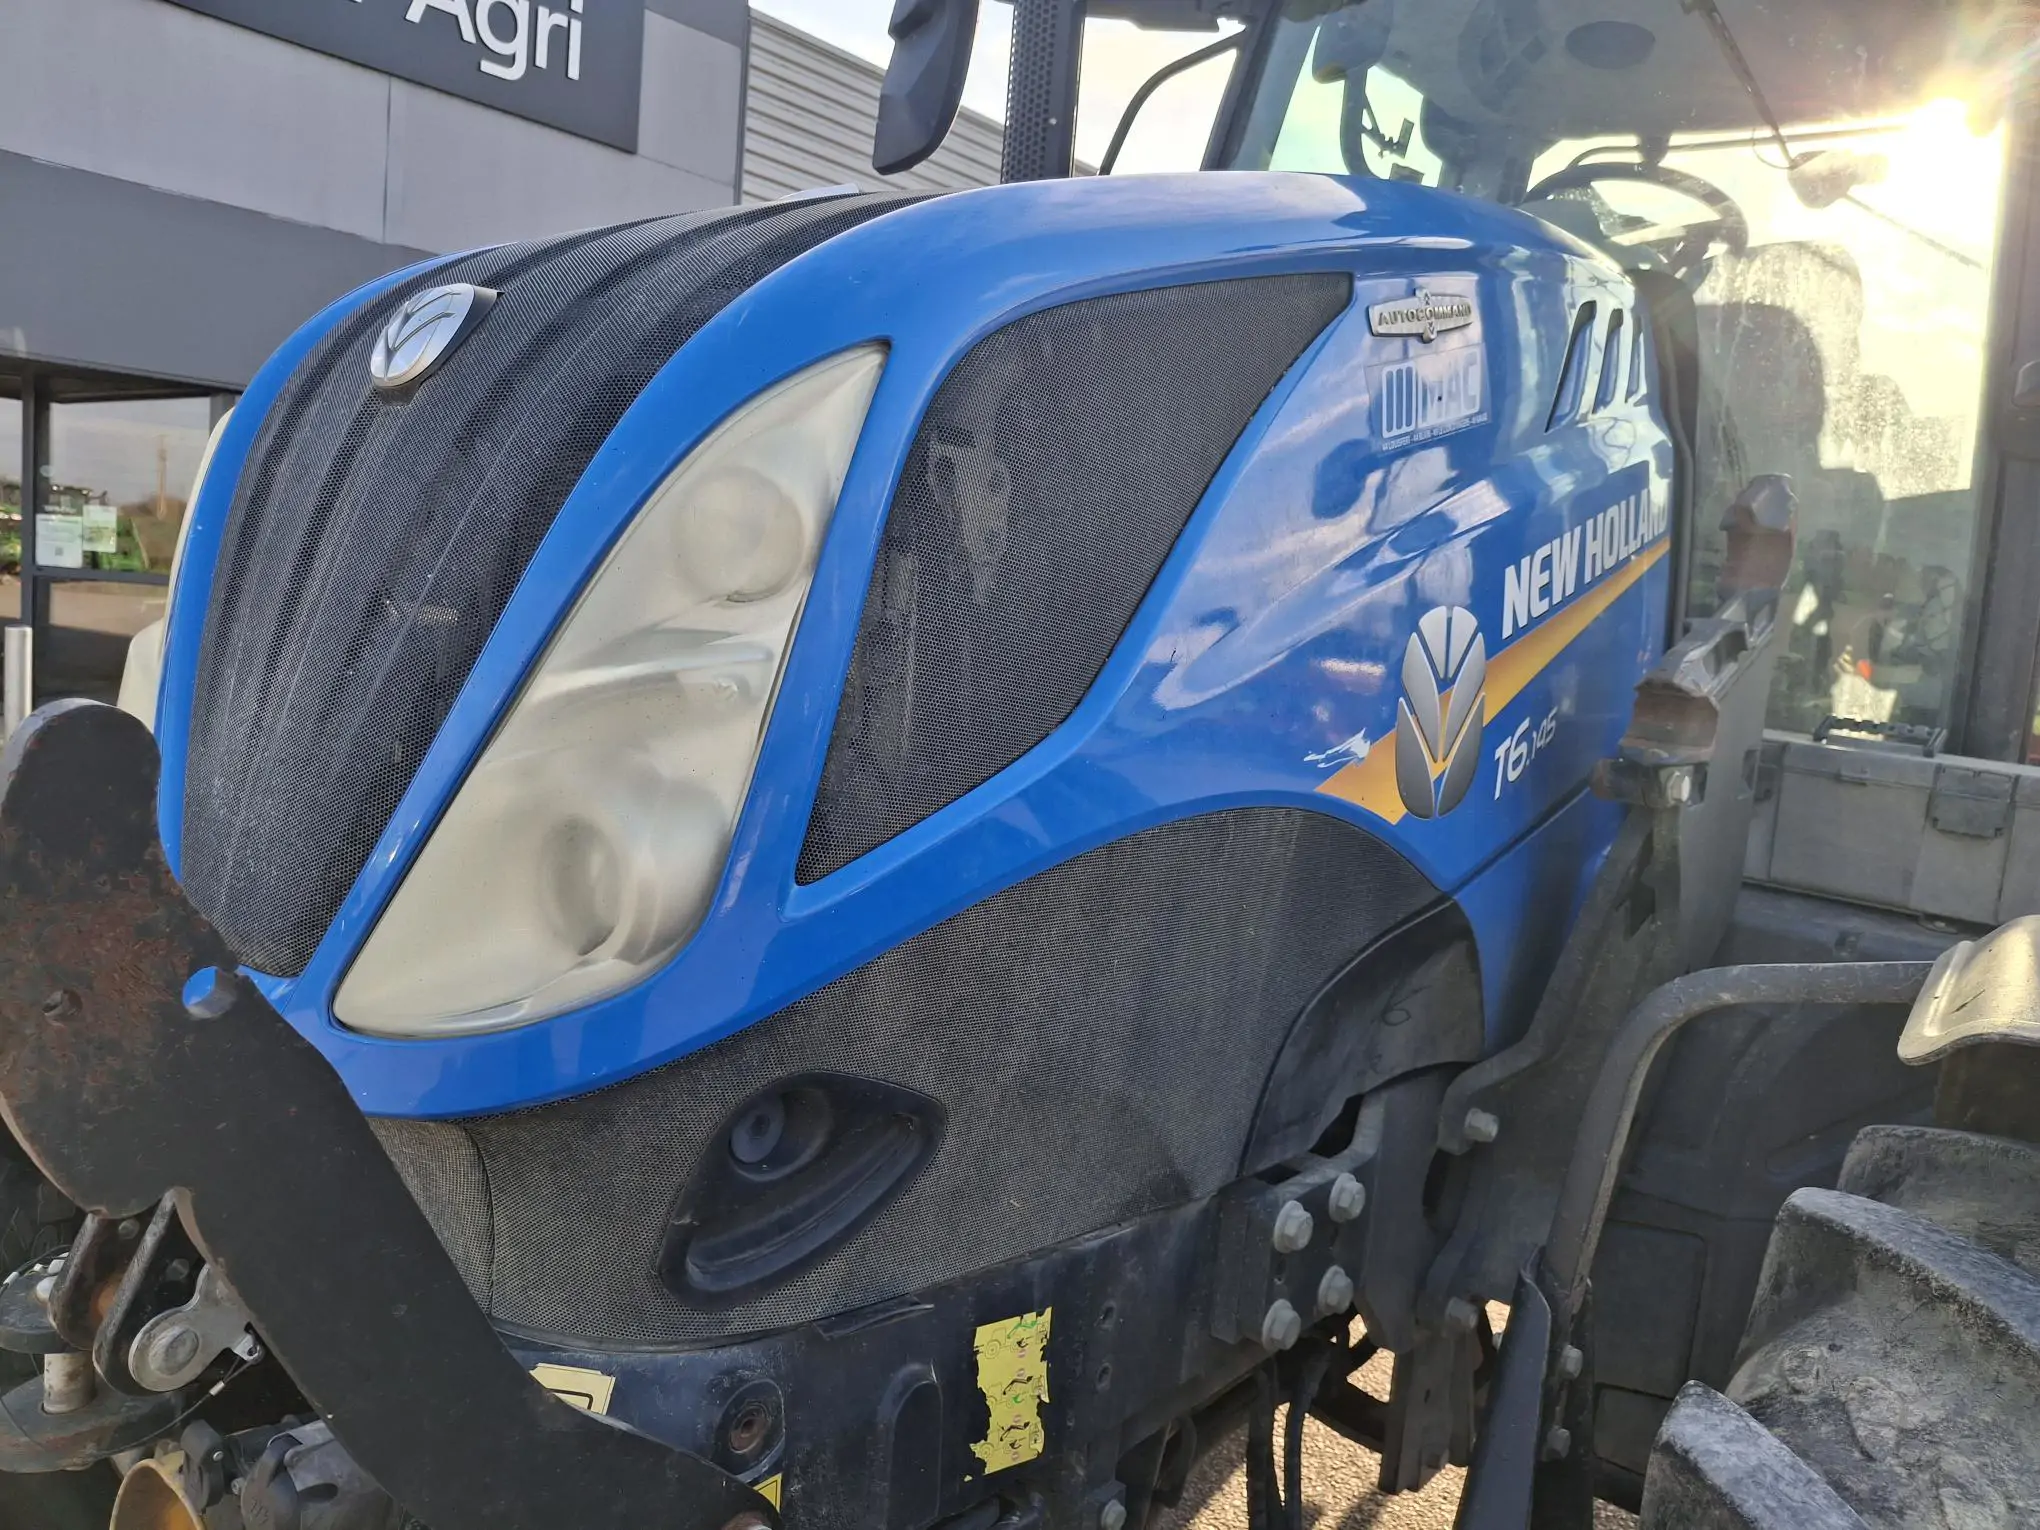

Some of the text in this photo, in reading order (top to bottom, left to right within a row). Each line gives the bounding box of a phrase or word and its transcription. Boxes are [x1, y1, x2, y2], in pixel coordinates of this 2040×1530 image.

[1378, 302, 1472, 326] AUTOCOMMAND
[1502, 481, 1668, 640] NEW HOLLAND
